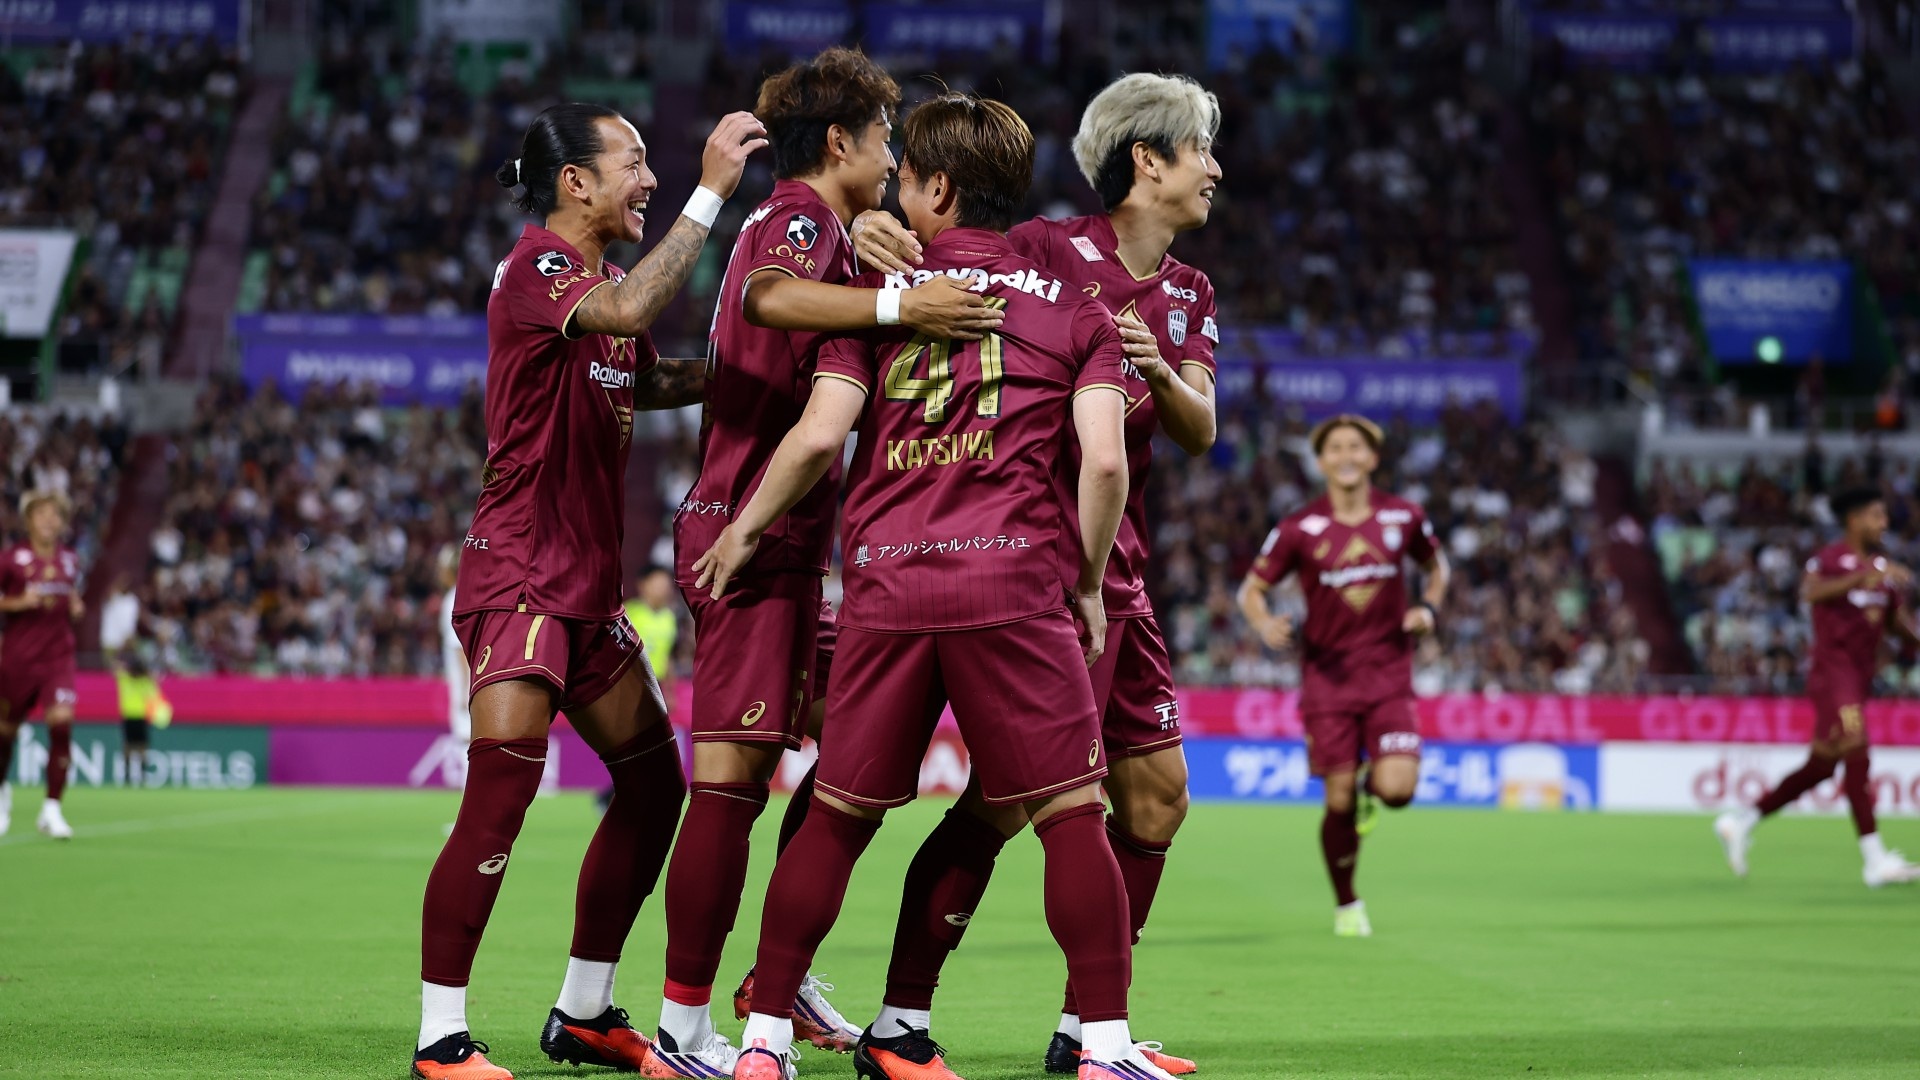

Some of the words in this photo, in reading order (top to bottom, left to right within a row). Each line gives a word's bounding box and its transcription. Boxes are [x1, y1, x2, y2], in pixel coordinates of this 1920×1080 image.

[884, 295, 1008, 423] 41
[887, 430, 994, 471] KATSUYA
[877, 535, 1031, 560] アンリ・シャルパンティエ
[1437, 694, 1603, 741] GOAL
[1639, 696, 1813, 741] GOAL
[112, 748, 256, 789] HOTELS
